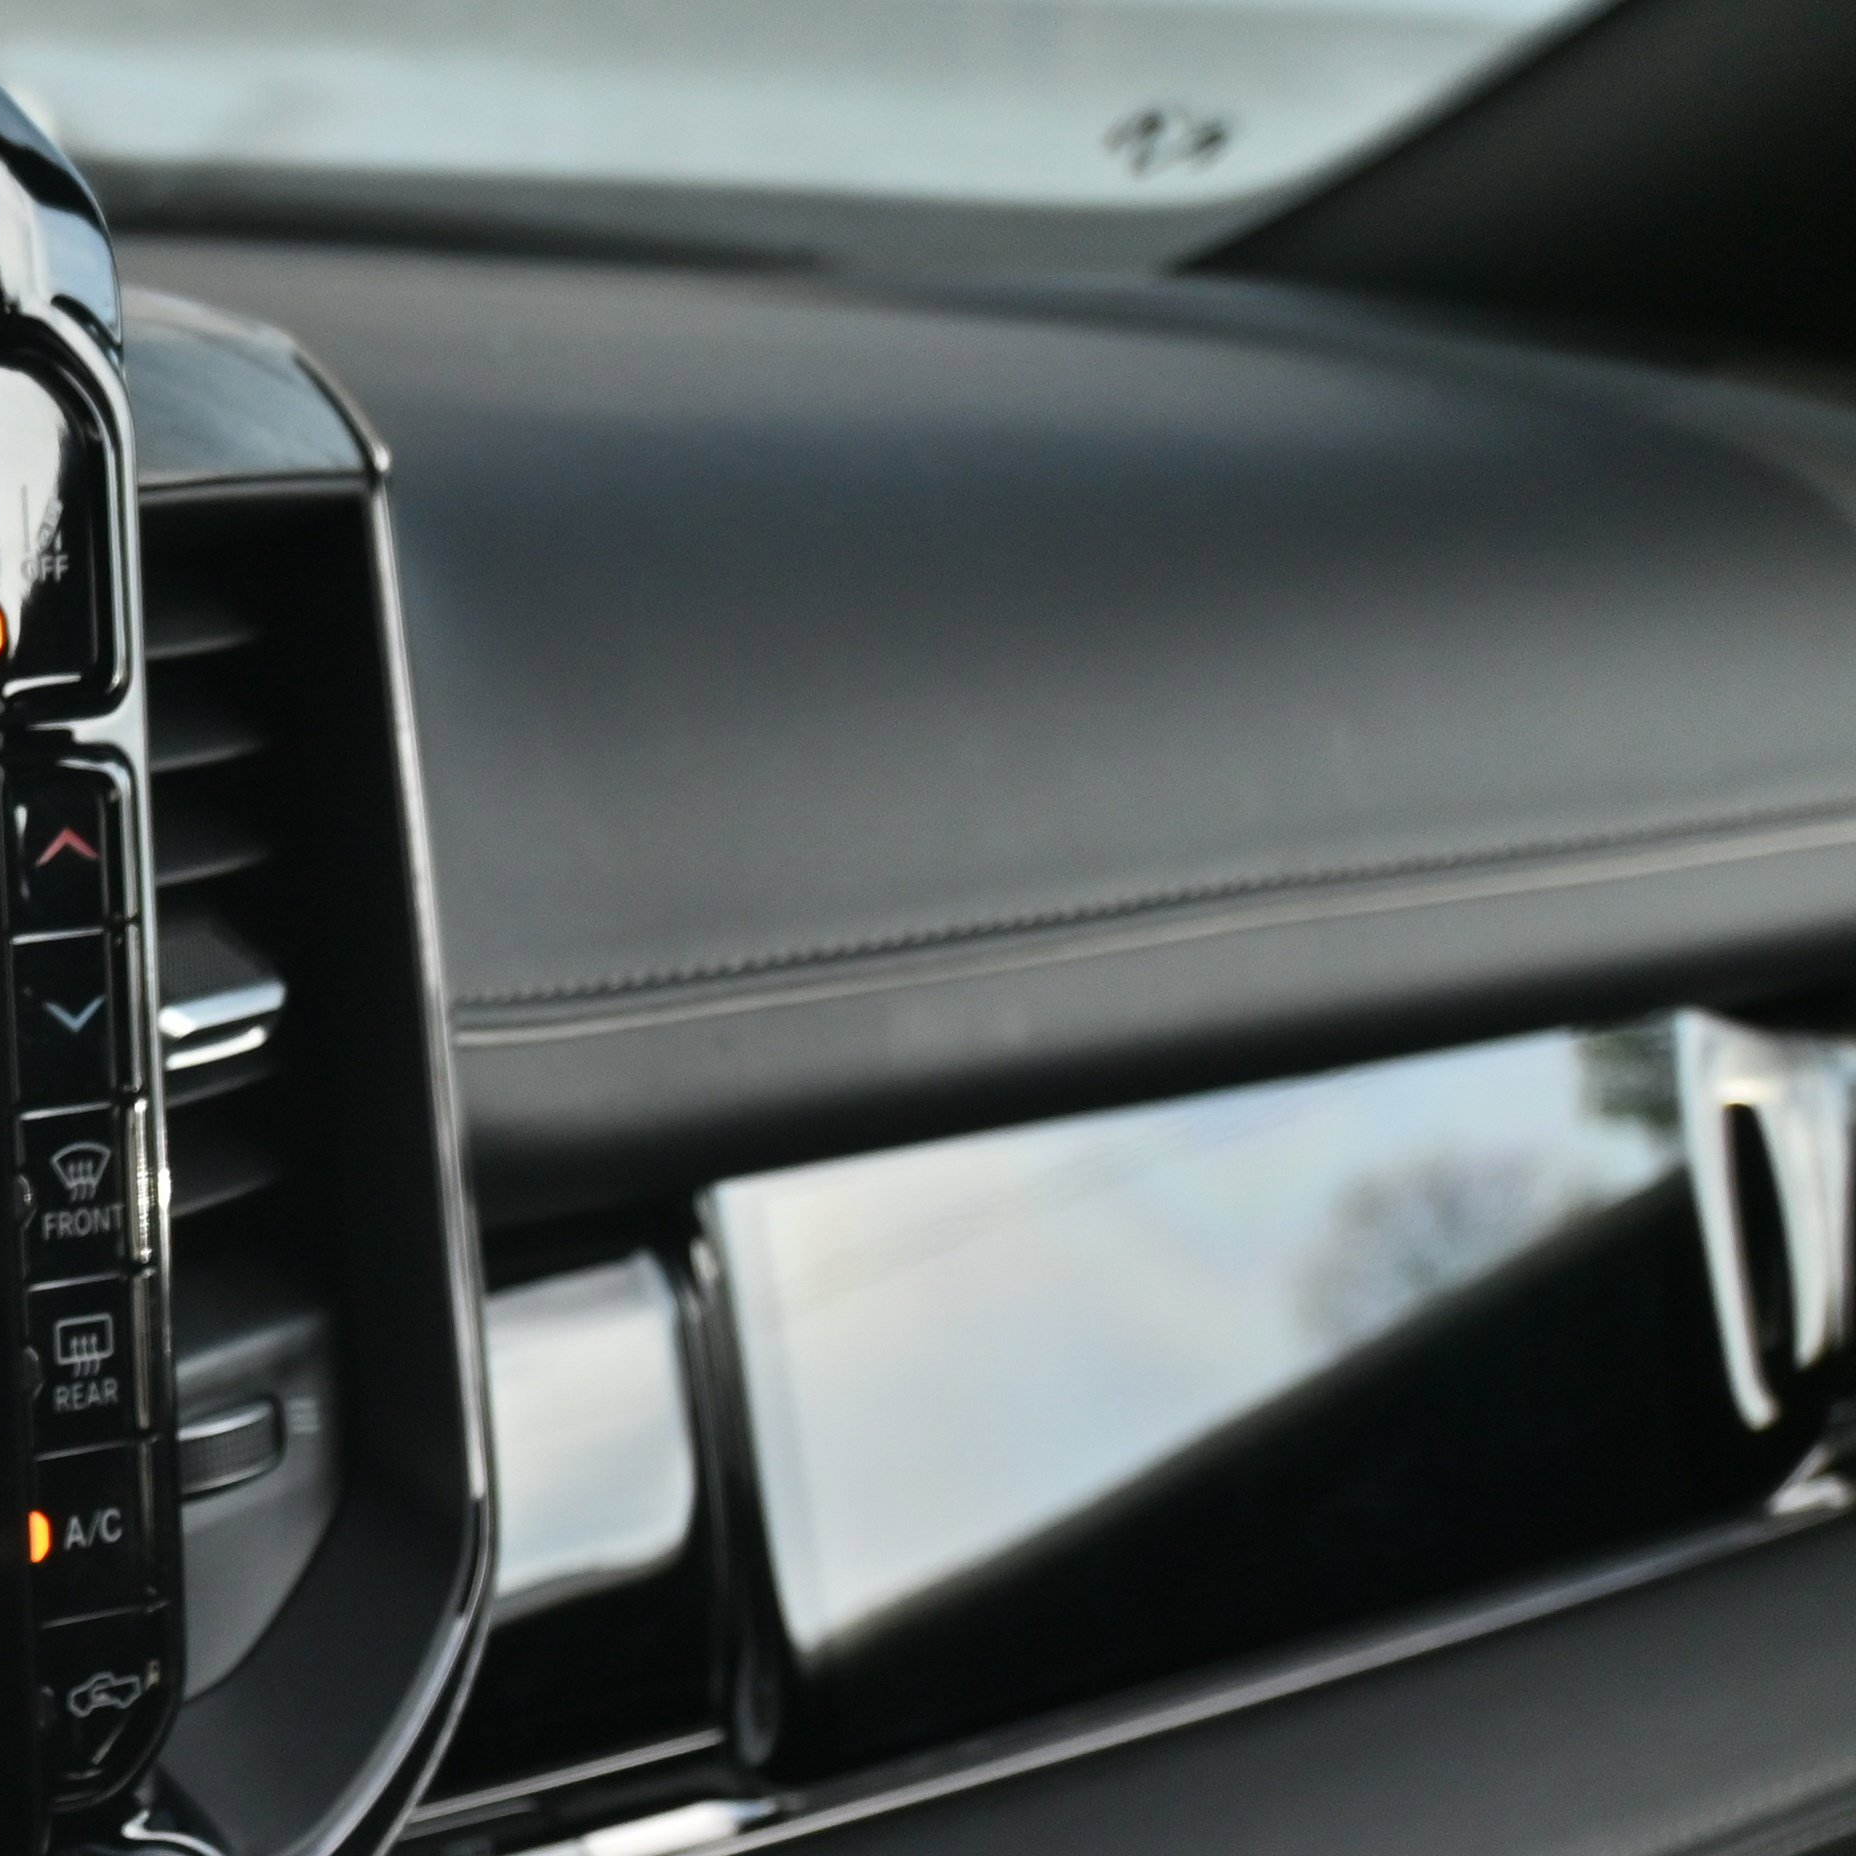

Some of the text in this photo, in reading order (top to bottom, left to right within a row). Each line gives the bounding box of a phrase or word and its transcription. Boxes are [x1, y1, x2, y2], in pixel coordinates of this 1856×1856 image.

[41, 1204, 124, 1242] FRONT
[52, 1378, 120, 1414] REAR
[62, 1508, 123, 1552] A/C
